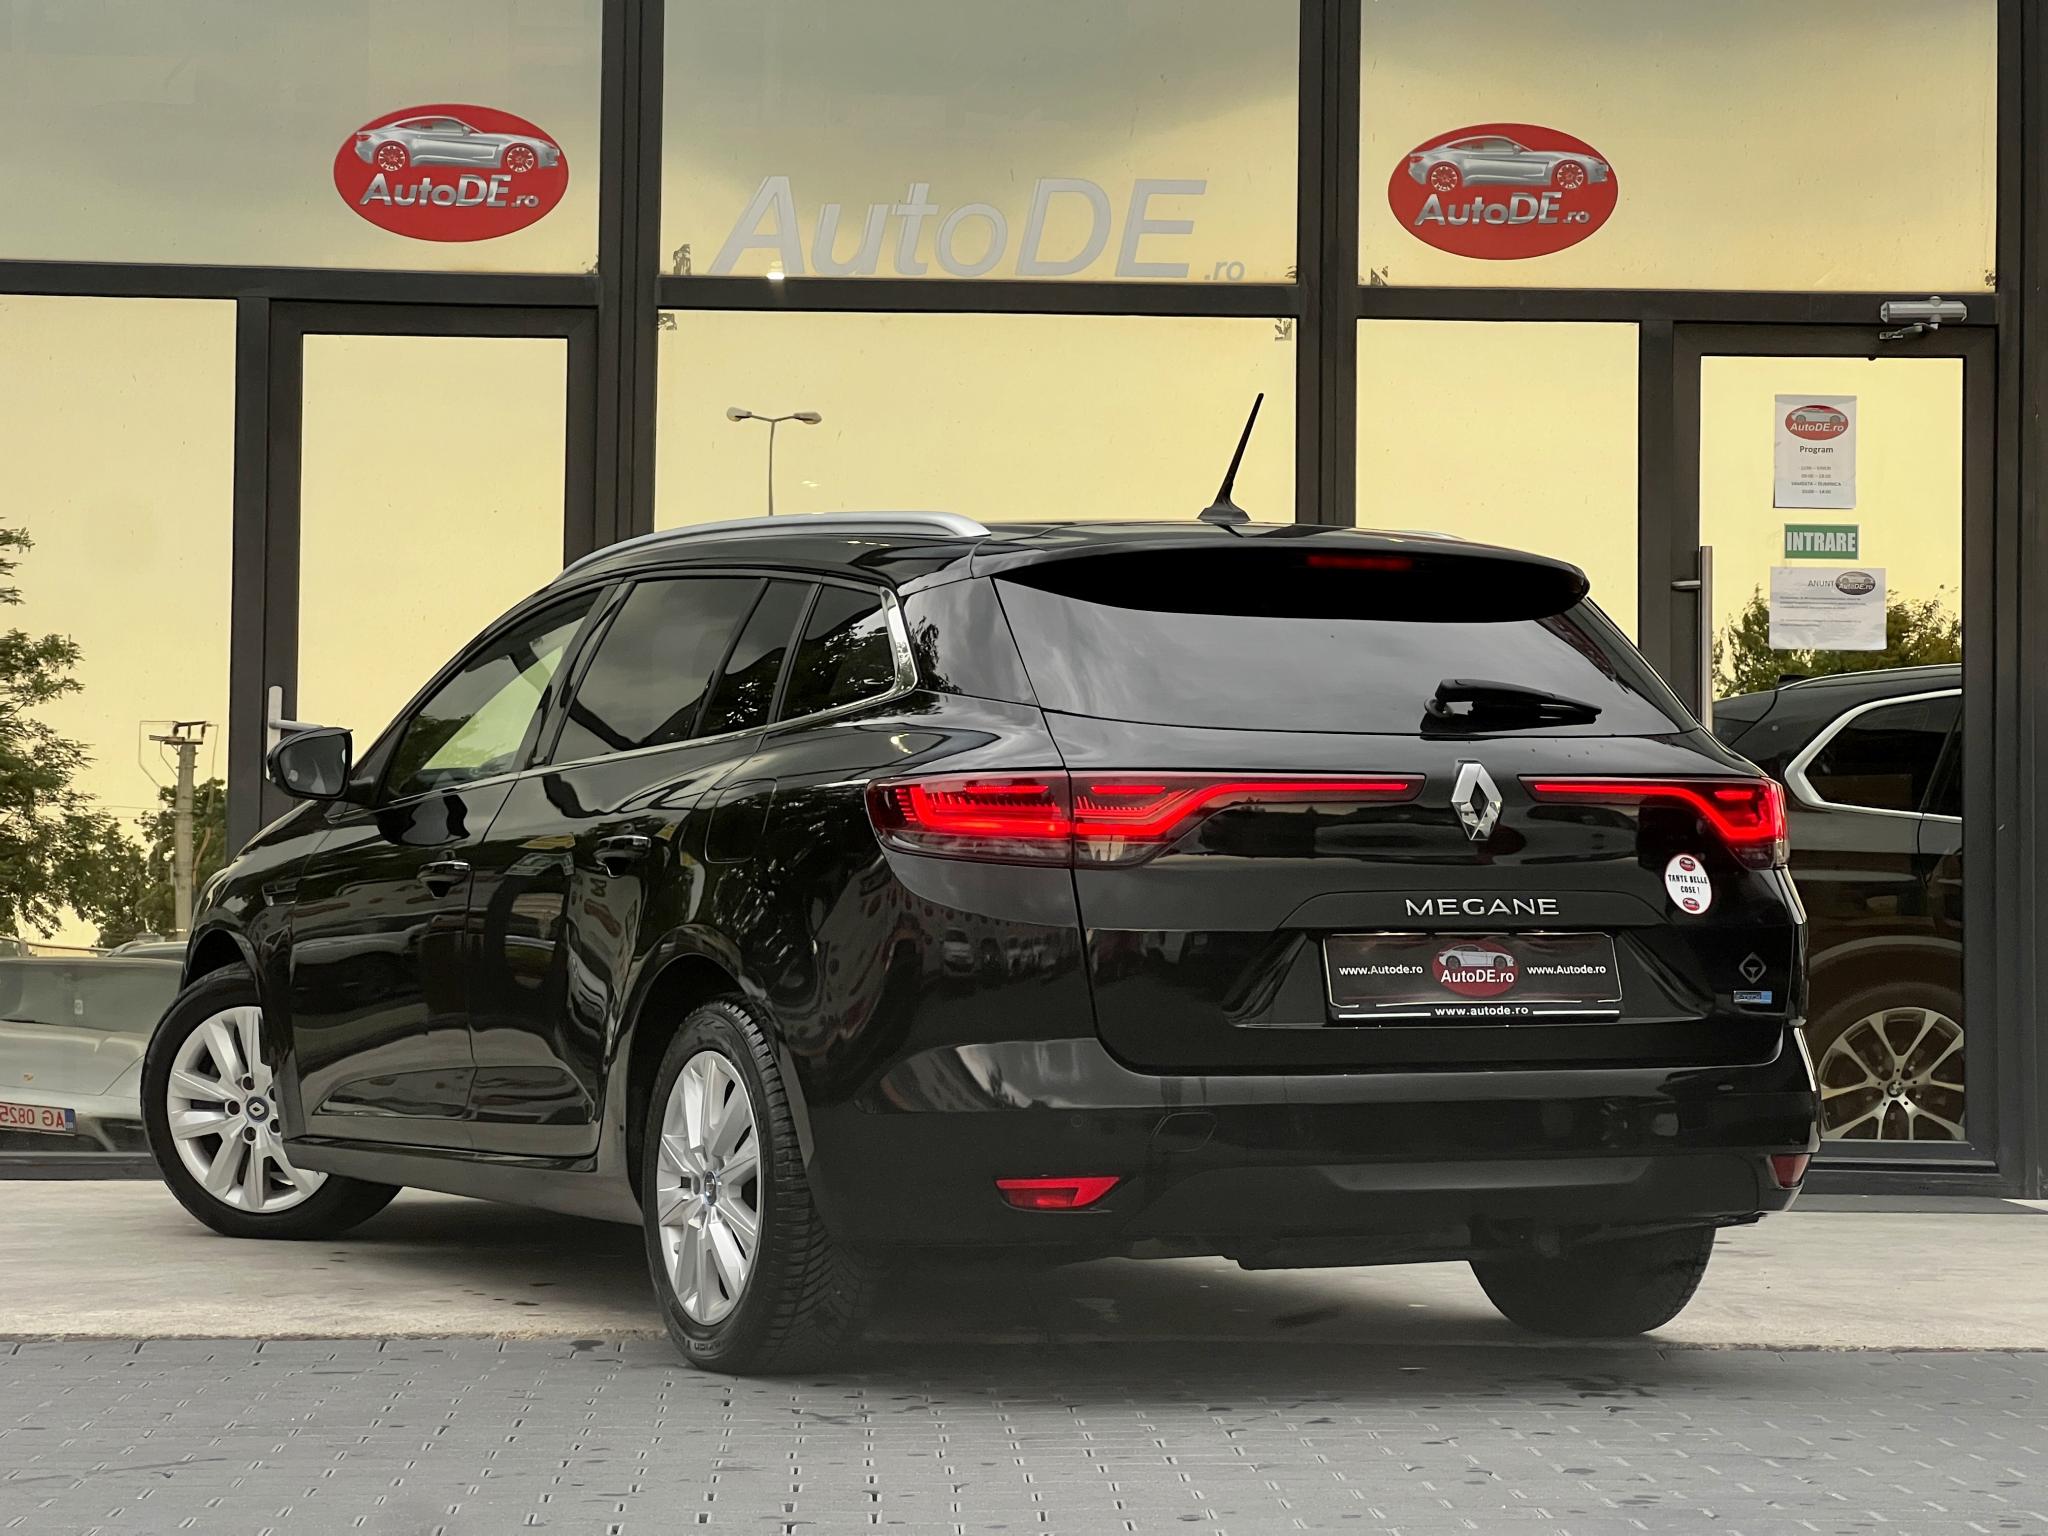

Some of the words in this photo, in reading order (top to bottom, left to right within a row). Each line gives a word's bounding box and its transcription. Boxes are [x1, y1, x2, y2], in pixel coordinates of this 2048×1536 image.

[1790, 422, 1844, 432] AutoDE.ro
[1799, 445, 1834, 454] Program
[1786, 531, 1856, 552] INTRARE
[1668, 874, 1688, 883] TANTE
[1405, 898, 1560, 916] MEGANE
[1339, 965, 1423, 976] www.Autode.ro
[1527, 965, 1607, 976] www.Autode.ro
[1440, 969, 1515, 984] AutoDE.ro
[1434, 1005, 1529, 1016] www.autode.ro
